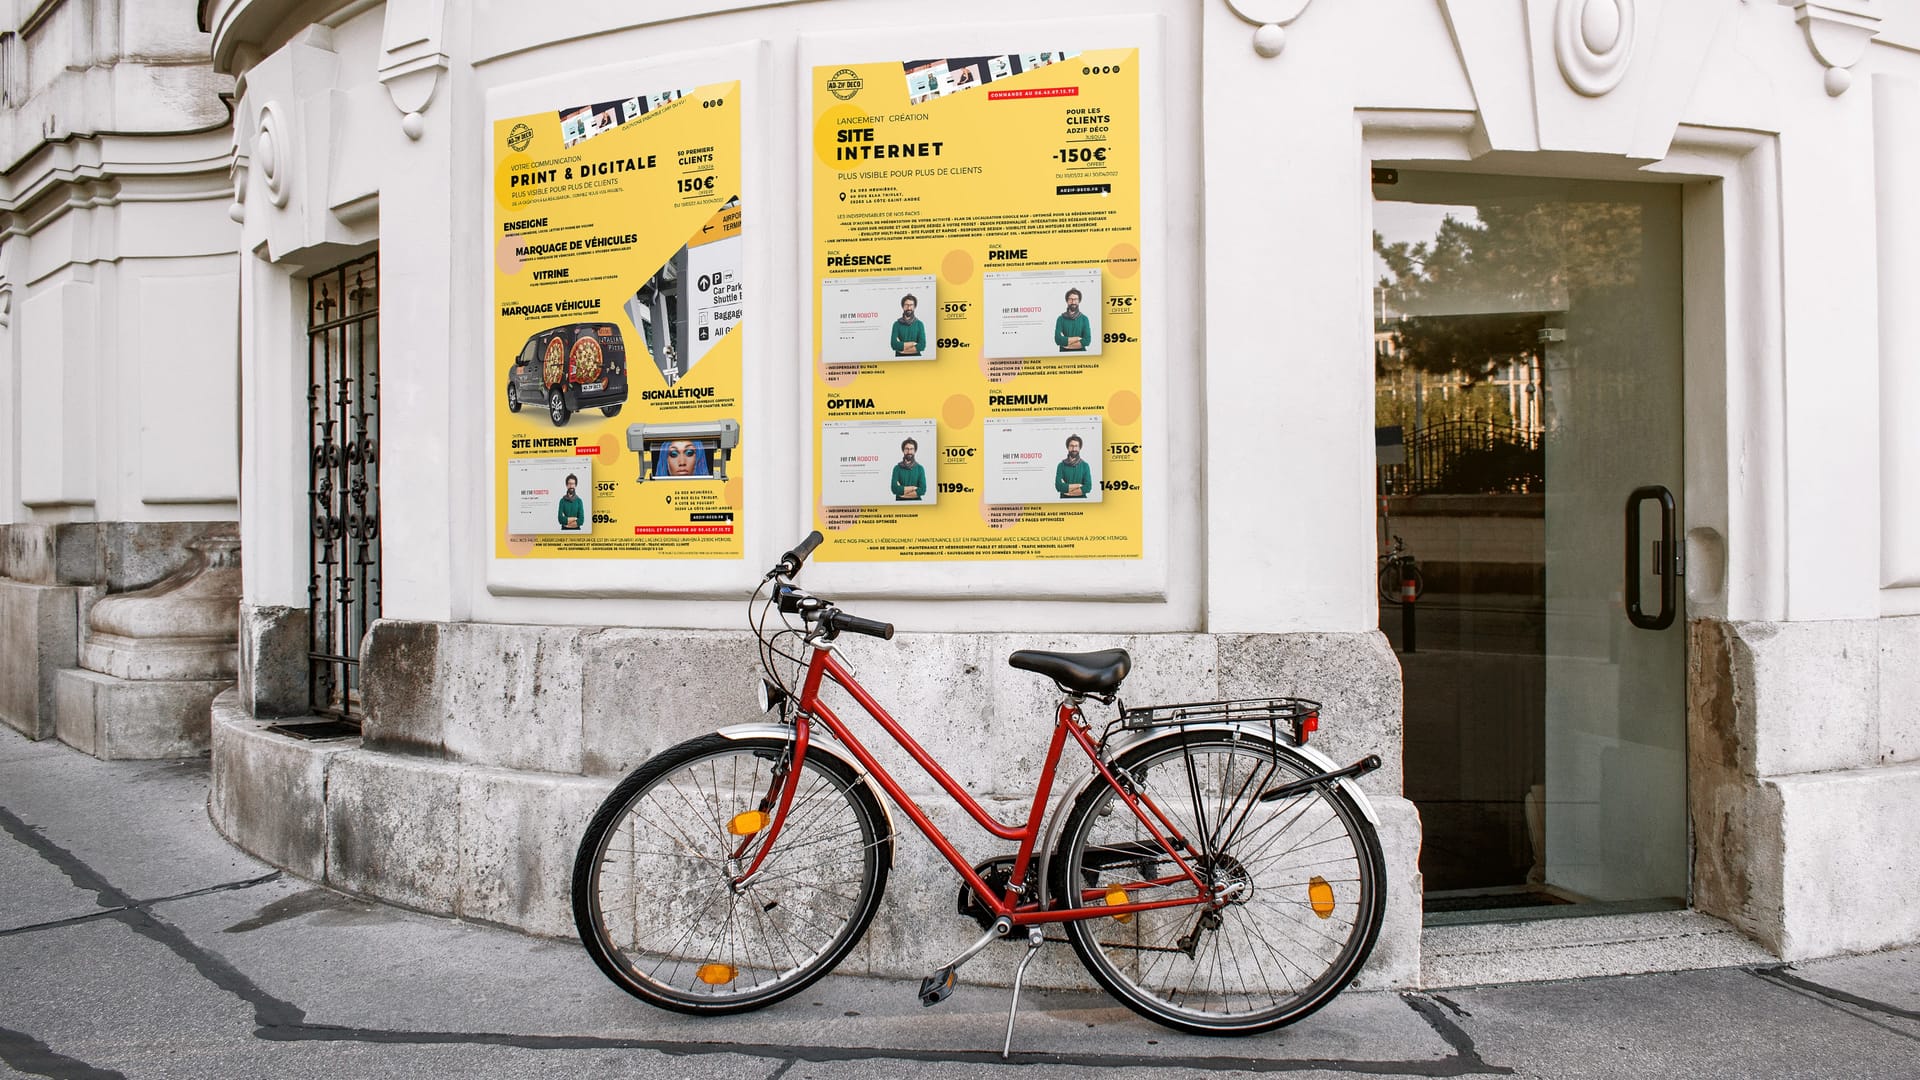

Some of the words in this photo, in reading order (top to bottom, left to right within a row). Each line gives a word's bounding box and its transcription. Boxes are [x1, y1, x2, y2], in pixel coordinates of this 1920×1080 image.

[837, 116, 884, 125] LANCEMENT
[889, 112, 929, 122] CRÉATION
[1066, 115, 1110, 125] CLIENTS
[837, 128, 874, 142] SITE
[686, 146, 714, 155] PREMIERS
[837, 142, 943, 160] INTERNET
[511, 162, 530, 171] VOTRE
[531, 155, 582, 168] COMMUNICATION
[678, 154, 713, 165] CLIENTS
[511, 170, 556, 187] PRINT
[565, 167, 572, 180] &
[581, 155, 656, 177] DIGITALE
[528, 187, 548, 196] VISIBLE
[550, 185, 566, 193] POUR
[568, 182, 583, 190] PLUS
[594, 178, 618, 187] CLIENTS
[504, 218, 548, 231] ENSEIGNE
[516, 242, 567, 256] MARQUAGE
[570, 240, 582, 250] DE
[585, 234, 638, 248] VÉHICULES
[827, 254, 891, 266] PRÉSENCE
[989, 250, 1028, 260] PRIME
[533, 268, 569, 280] VITRINE
[713, 286, 724, 295] Car
[727, 282, 742, 293] Park
[713, 293, 738, 304] Shuttle
[502, 304, 552, 316] MARQUAGE
[556, 299, 600, 311] VÉHICULE
[715, 327, 724, 336] All
[642, 386, 714, 400] SIGNALÉTIQUE
[827, 399, 875, 409] OPTIMA
[989, 394, 1048, 405] PREMIUM
[512, 439, 531, 448] SITE
[533, 437, 578, 448] INTERNET
